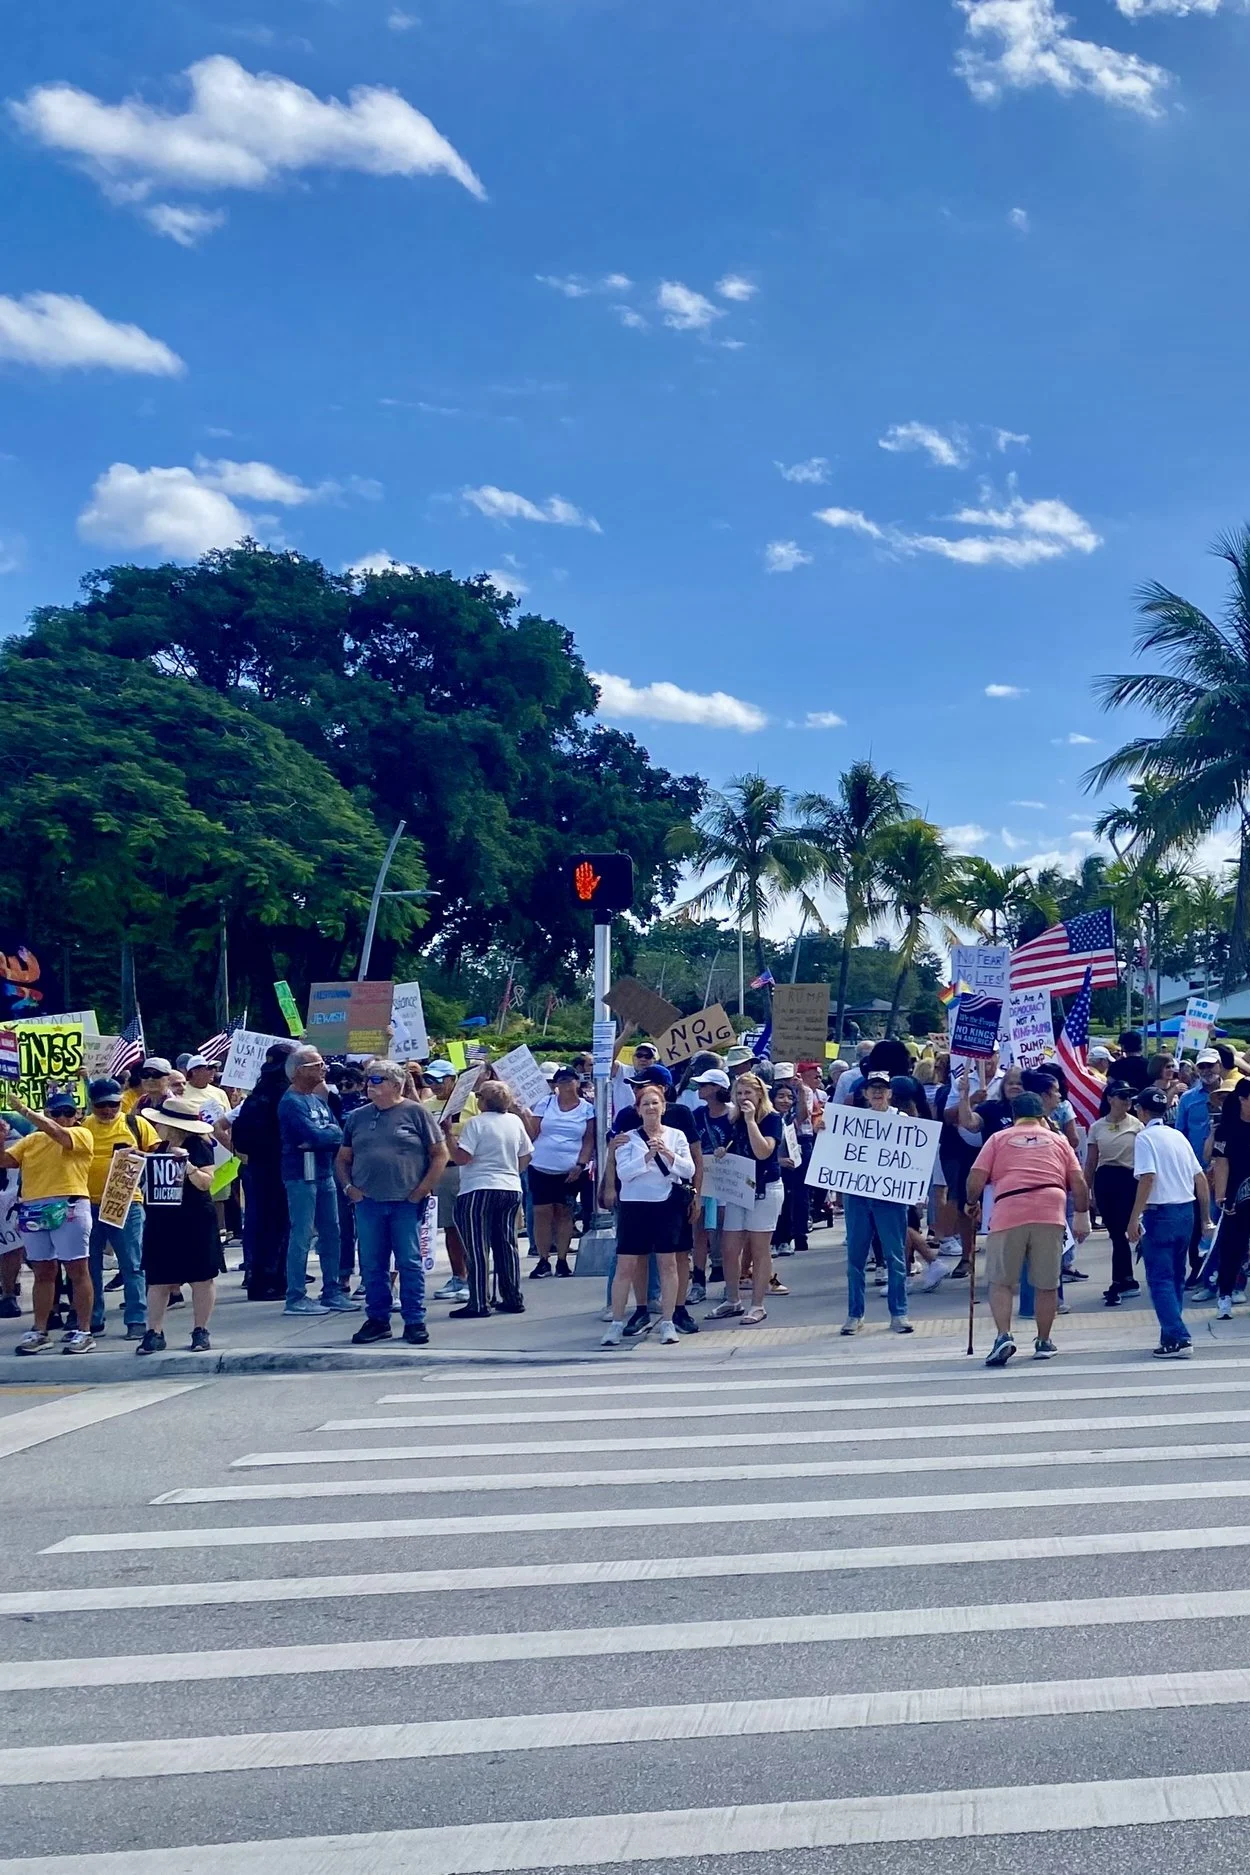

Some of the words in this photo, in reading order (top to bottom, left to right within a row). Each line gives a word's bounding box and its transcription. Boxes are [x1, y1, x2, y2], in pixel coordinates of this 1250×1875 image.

[666, 1025, 731, 1060] KING
[670, 1018, 706, 1045] NO
[955, 1024, 969, 1036] NO
[970, 1026, 996, 1040] KINGS
[832, 1114, 839, 1134] I
[842, 1115, 893, 1142] KNEW
[896, 1125, 928, 1148] IT'D
[844, 1142, 869, 1163] BE
[882, 1176, 925, 1202] SHIT!
[102, 1201, 125, 1218] 1776
